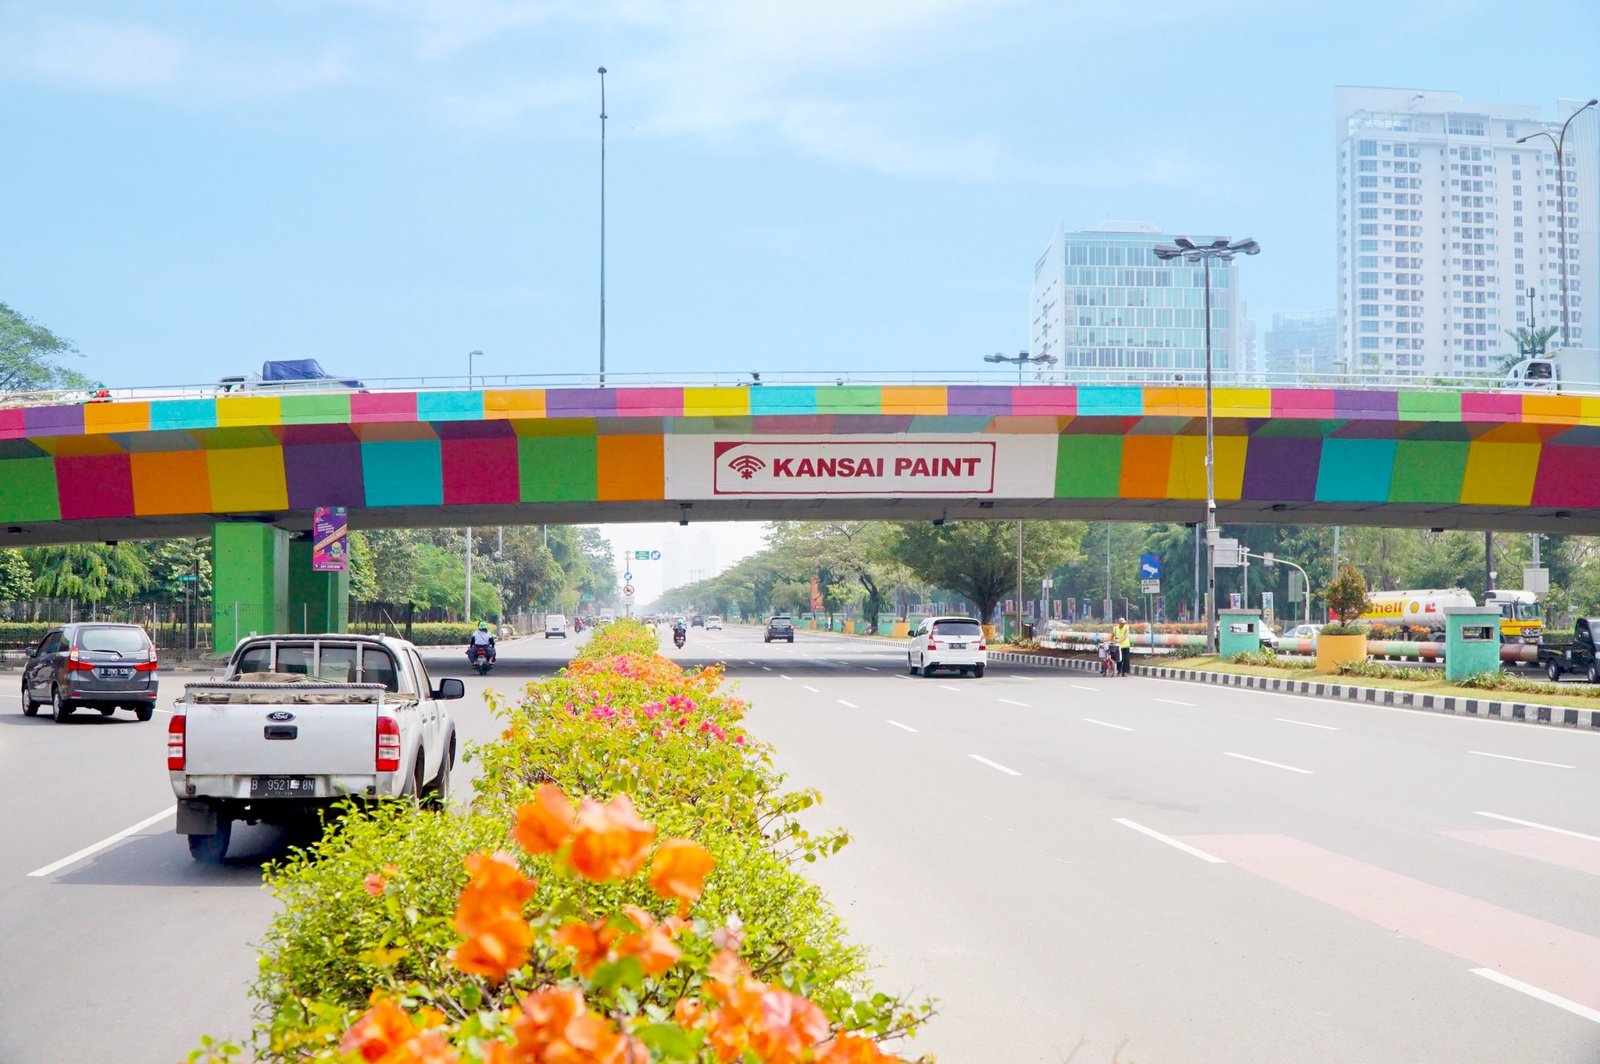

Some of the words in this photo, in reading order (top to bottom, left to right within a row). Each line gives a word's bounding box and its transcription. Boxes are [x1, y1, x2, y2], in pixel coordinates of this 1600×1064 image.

[773, 457, 884, 478] KANSAI
[894, 457, 981, 477] PAINT
[272, 712, 289, 720] Ford
[251, 780, 258, 790] B
[267, 780, 290, 790] 9521
